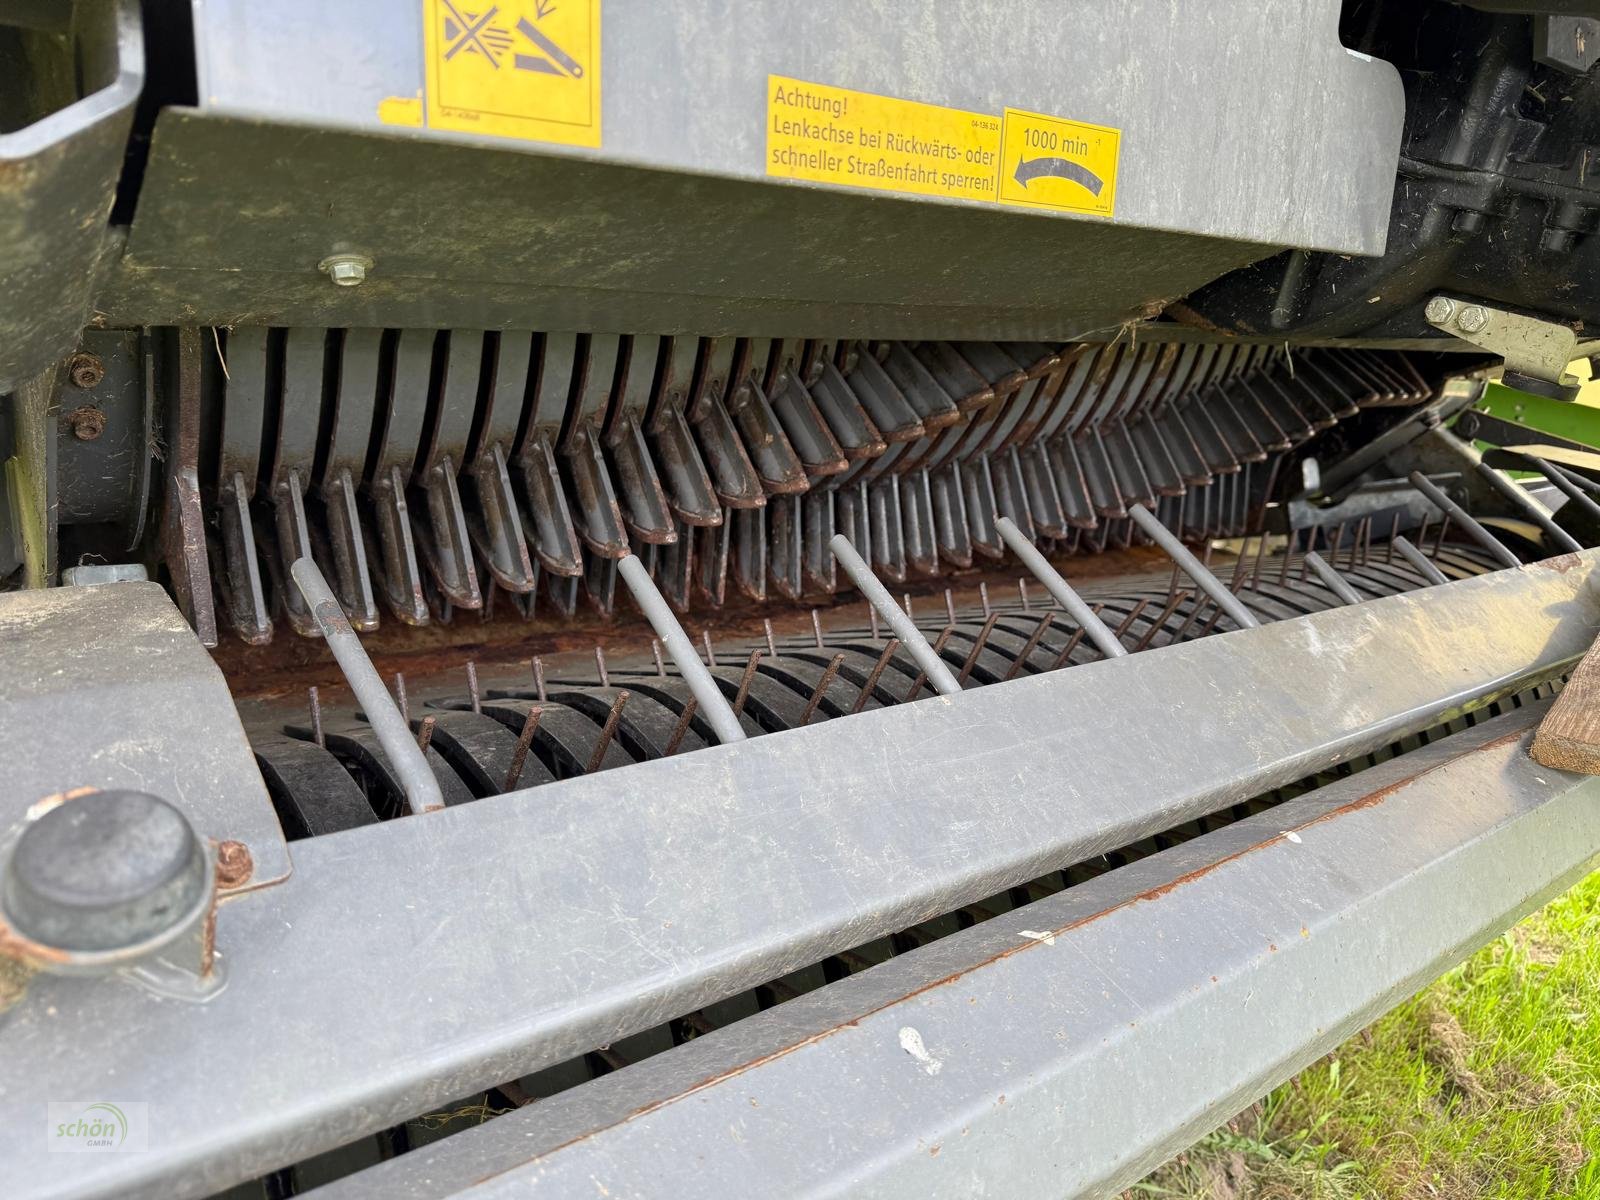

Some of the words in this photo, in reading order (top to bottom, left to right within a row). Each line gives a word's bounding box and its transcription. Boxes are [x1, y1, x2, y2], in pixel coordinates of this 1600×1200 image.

[774, 85, 847, 118] Achtung!
[774, 115, 855, 144] Lenkachse
[859, 128, 881, 147] bei
[886, 132, 961, 160] Rückwärts-
[966, 146, 995, 166] oder
[1023, 128, 1057, 150] 1000
[1062, 137, 1088, 156] min
[773, 145, 843, 172] schneller
[848, 155, 938, 185] Straßenfahrt
[941, 172, 994, 192] sperren!
